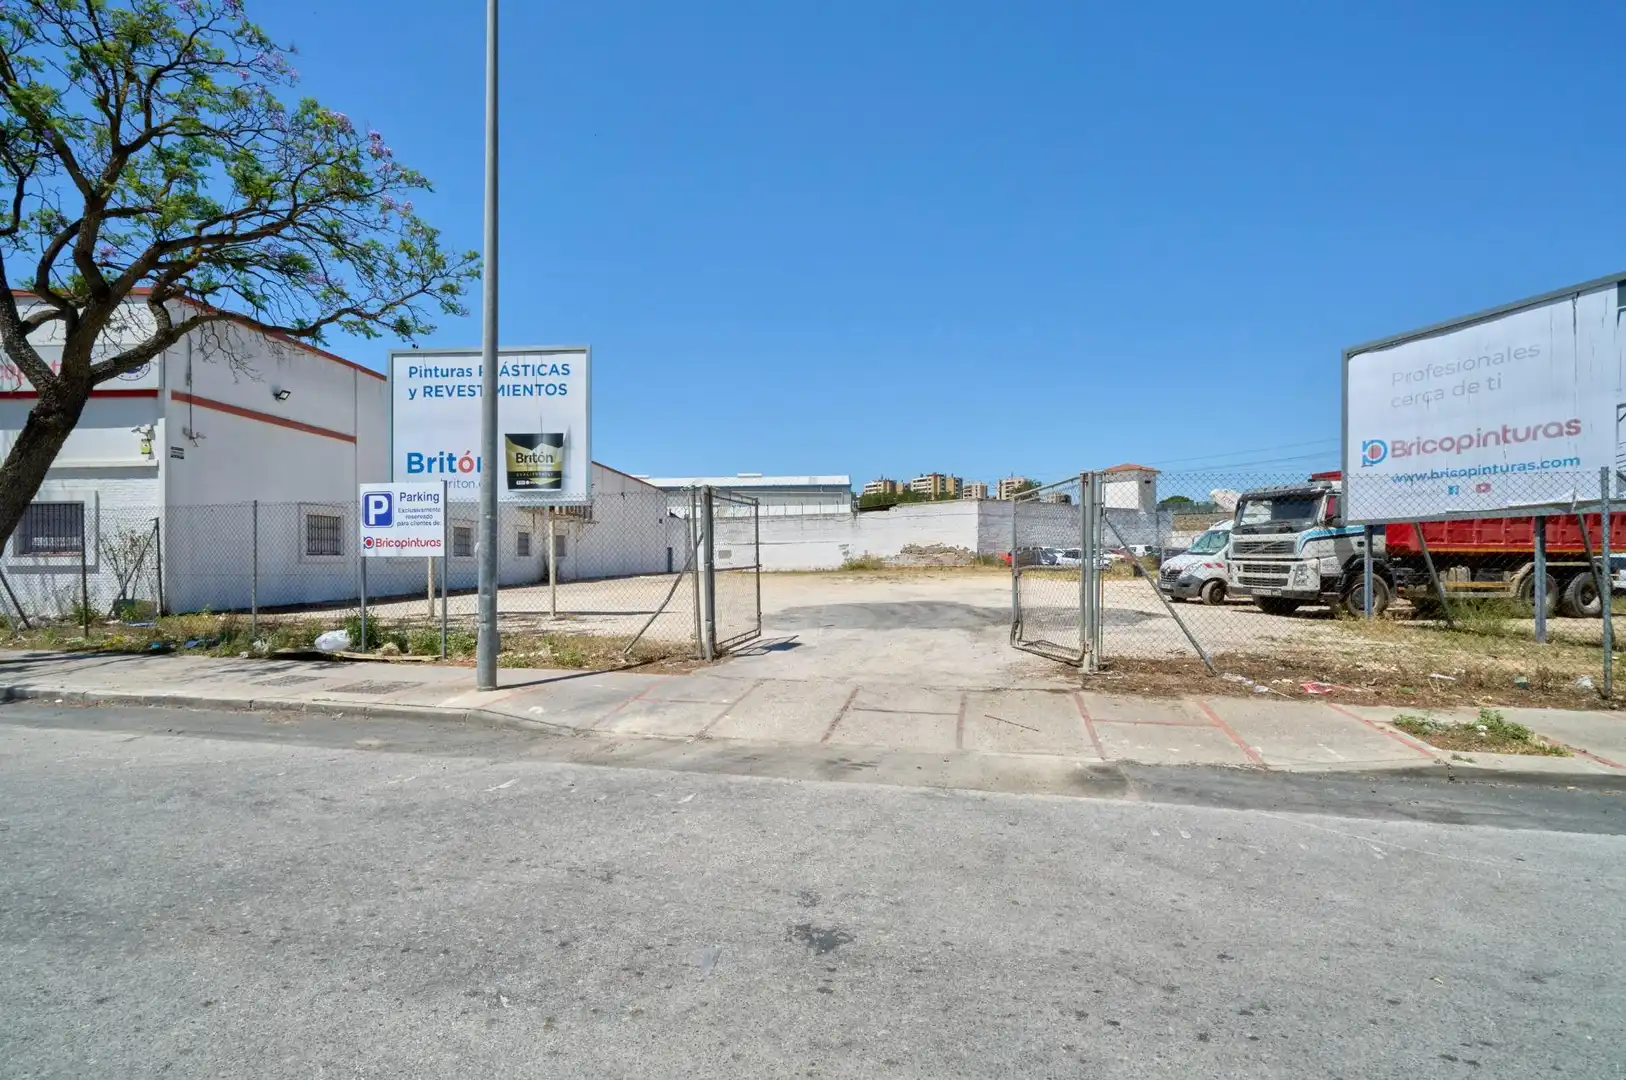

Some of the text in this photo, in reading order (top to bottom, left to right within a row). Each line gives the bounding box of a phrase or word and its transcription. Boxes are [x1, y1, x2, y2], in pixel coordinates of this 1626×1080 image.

[408, 361, 570, 378] Pinturas ÁSTICAS
[1391, 344, 1541, 386] Profesionales
[408, 384, 568, 400] y REVESTMIENTOS
[1452, 380, 1480, 397] de
[1487, 373, 1502, 391] ti
[1391, 418, 1582, 458] Bricopinturas
[516, 452, 553, 463] Britón
[1391, 456, 1581, 484] www.bricopinturas.com
[400, 492, 440, 504] Parking
[375, 537, 442, 549] Bricopinturas
